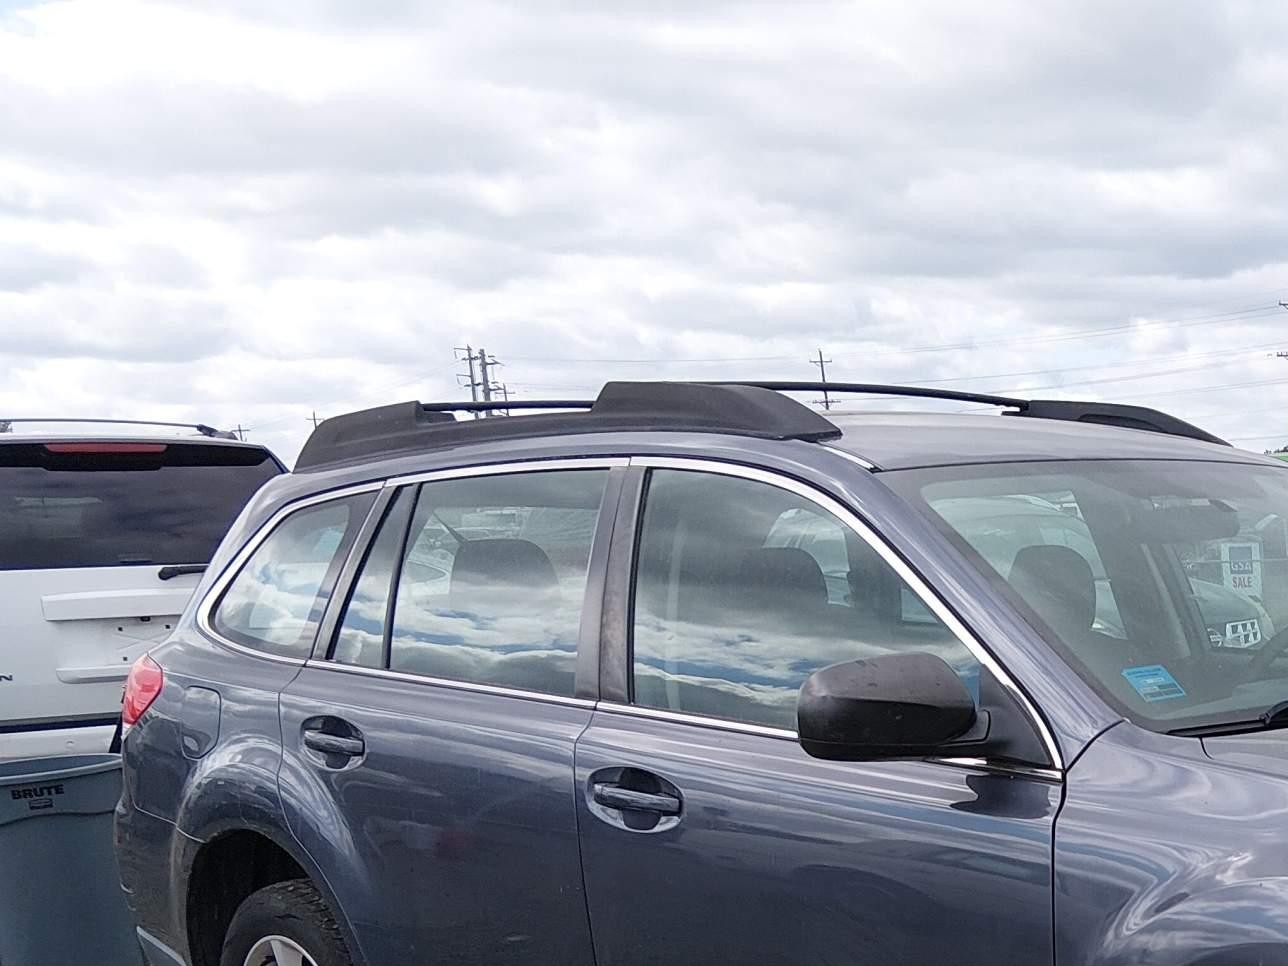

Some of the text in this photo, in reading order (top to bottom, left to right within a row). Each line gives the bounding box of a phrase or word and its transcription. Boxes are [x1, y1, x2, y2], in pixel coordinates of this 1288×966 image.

[1231, 561, 1252, 571] GSA
[1232, 575, 1253, 589] SALE
[11, 784, 65, 800] BRUTE
